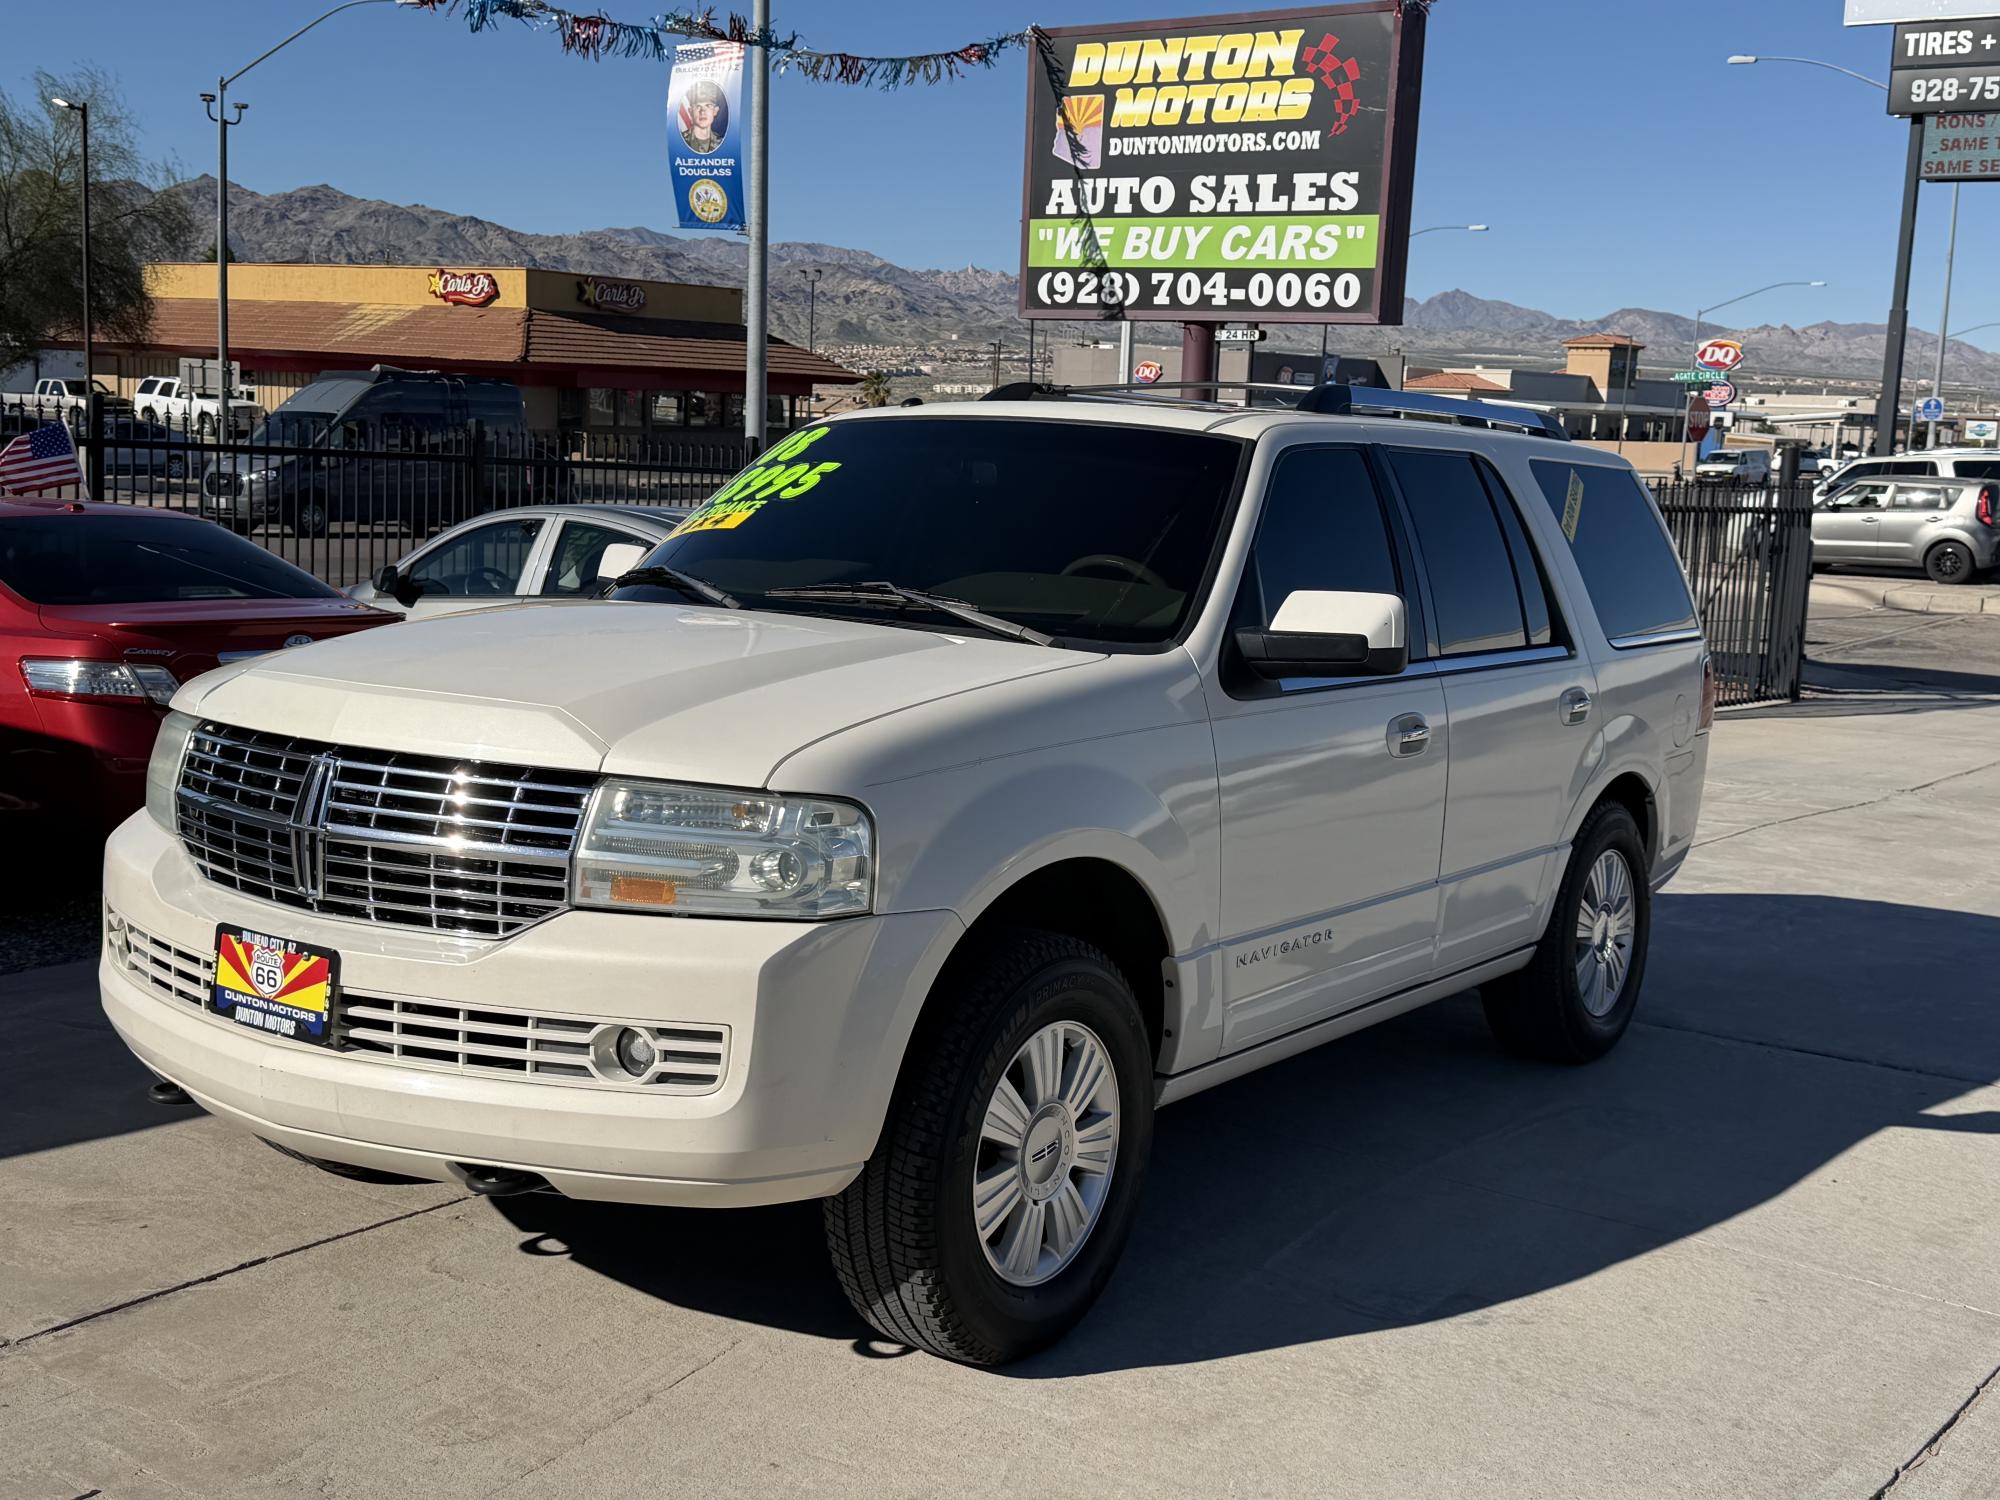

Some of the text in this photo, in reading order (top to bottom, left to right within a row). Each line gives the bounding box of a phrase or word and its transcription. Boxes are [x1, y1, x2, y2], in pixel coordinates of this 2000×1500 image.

[1905, 30, 1973, 56] TIRES
[1068, 29, 1305, 87] DUNTON
[1911, 76, 2000, 102] 928-75
[1110, 78, 1315, 127] MOTORS
[1109, 130, 1321, 156] DUNTONMOTORS.COM
[1940, 137, 1989, 151] SAME
[675, 157, 736, 166] ALEXANDER
[679, 167, 732, 176] DOUGLASS
[1924, 160, 1973, 174] SAME
[1045, 172, 1359, 214] AUTO SALES
[1122, 226, 1214, 260] BUY
[1220, 224, 1365, 260] CARS"
[1037, 271, 1361, 307] (928) 704-0060
[1226, 331, 1237, 339] 24
[1242, 330, 1256, 339] HR
[1702, 346, 1736, 364] DQ
[1139, 366, 1155, 378] DQ
[1674, 372, 1725, 380] AGATE CIRCLE
[1689, 411, 1709, 427] STOP
[287, 942, 297, 953] AZ
[1236, 929, 1333, 968] NAVIGATOR
[256, 953, 278, 966] ROUTE
[255, 966, 277, 988] 66
[224, 989, 316, 1022] DUNTON MOTORS
[235, 1005, 296, 1036] DUNTON MOTORS
